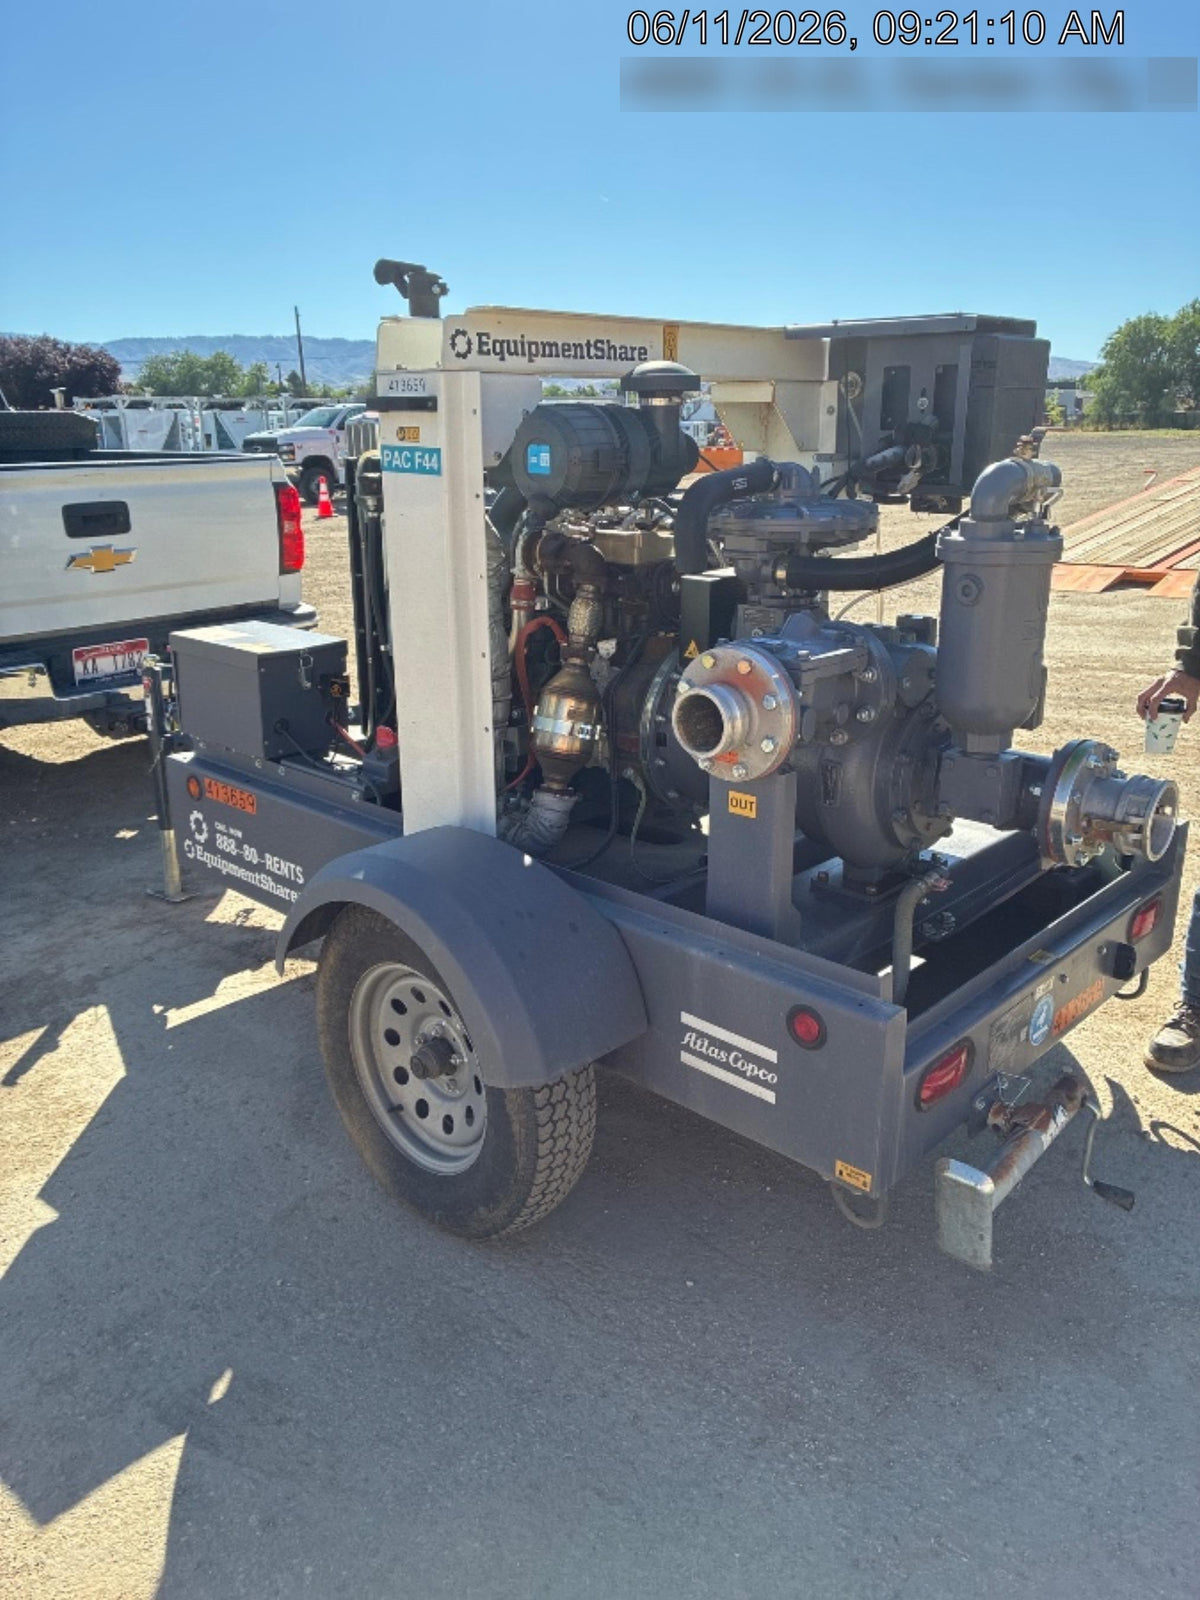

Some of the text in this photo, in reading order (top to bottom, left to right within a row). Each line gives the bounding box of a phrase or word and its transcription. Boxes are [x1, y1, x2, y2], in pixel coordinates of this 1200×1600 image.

[476, 332, 648, 363] EquipmentShare
[383, 449, 439, 471] PAC F44
[730, 797, 755, 812] OUT
[195, 844, 298, 903] EquipmentShare
